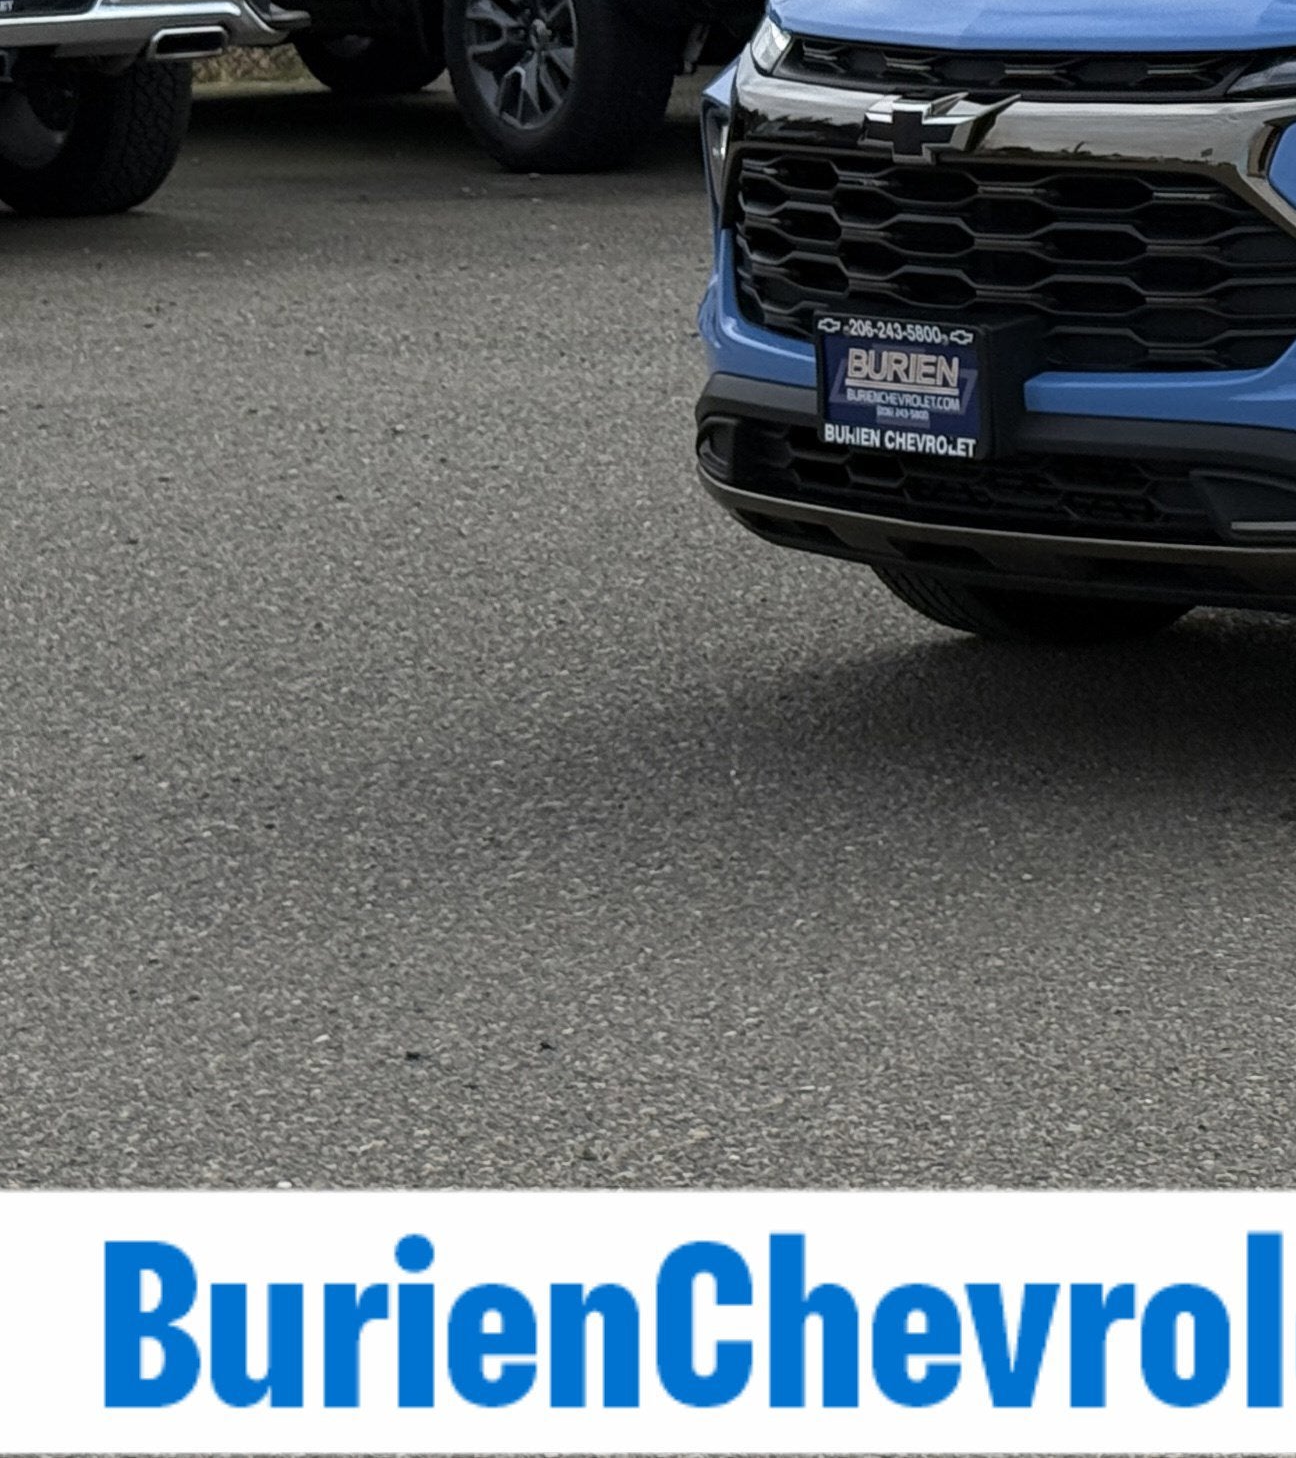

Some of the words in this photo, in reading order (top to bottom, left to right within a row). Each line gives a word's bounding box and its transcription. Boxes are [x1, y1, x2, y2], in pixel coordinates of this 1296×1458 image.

[848, 318, 942, 343] 206-243-5800
[848, 347, 959, 387] BURIEN
[846, 387, 960, 411] BURIENCHEVROLET.COM
